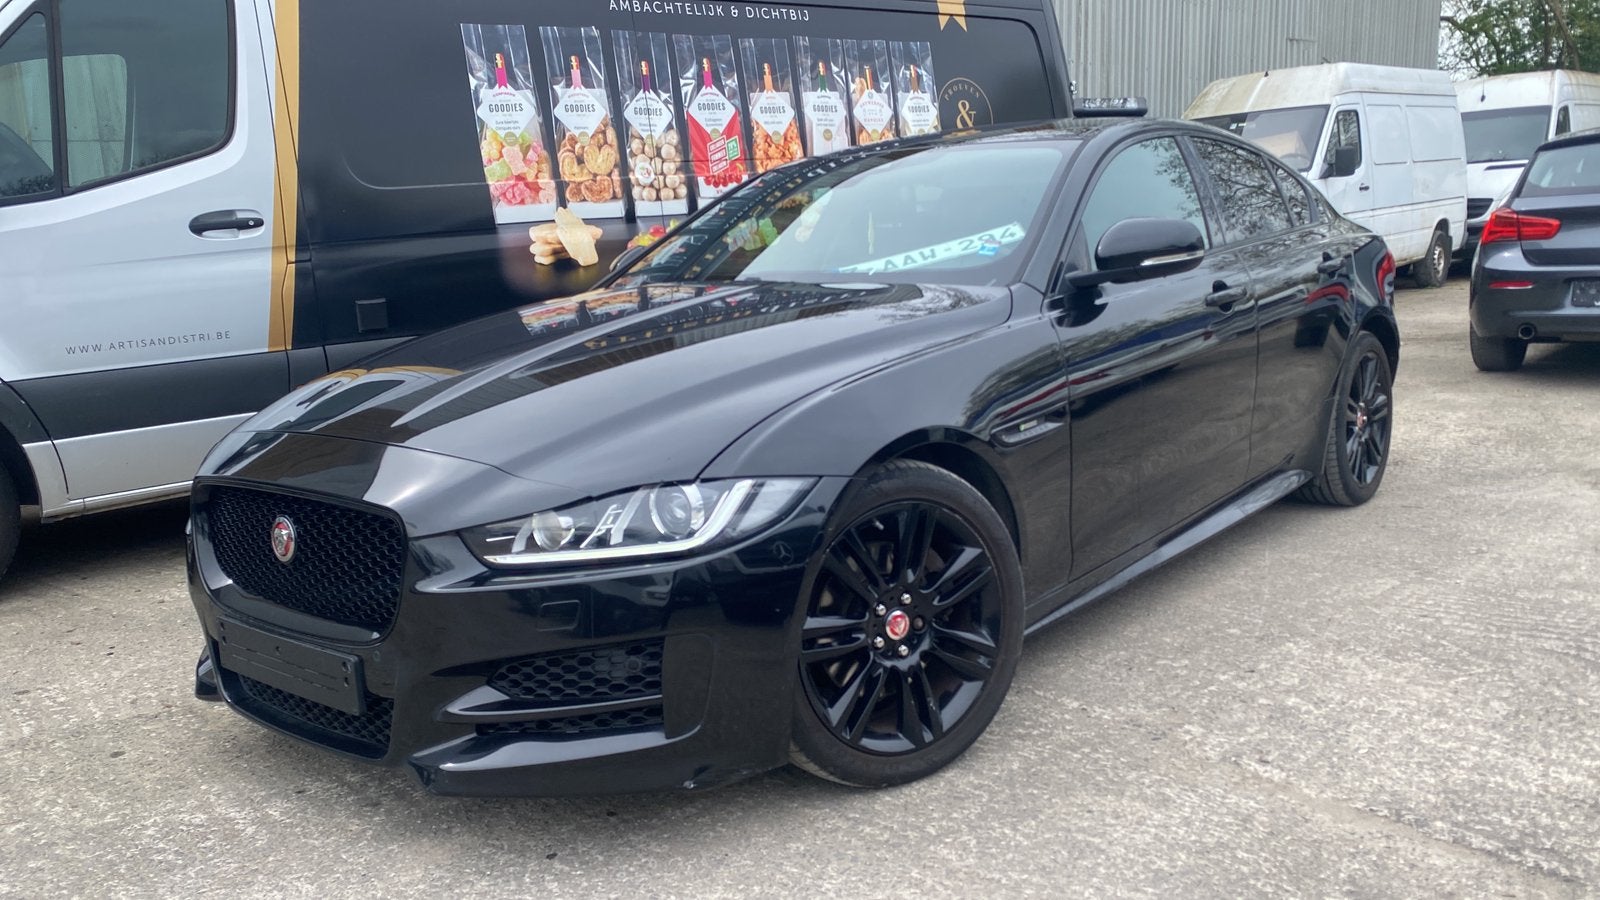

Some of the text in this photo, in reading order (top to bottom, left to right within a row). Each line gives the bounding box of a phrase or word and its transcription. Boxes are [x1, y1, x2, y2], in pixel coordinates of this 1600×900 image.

[609, 0, 809, 21] AMBACHTELIJK & DICHTBIJ
[488, 103, 524, 113] GOODIES
[564, 103, 596, 113] GOODIES
[633, 107, 663, 117] GOODIES
[697, 103, 726, 111] GOODIES
[760, 105, 786, 114] GOODIES
[812, 104, 838, 113] GOODIES
[956, 100, 977, 128] &
[65, 330, 231, 355] WWW.ARTISANDISTRI.BE
